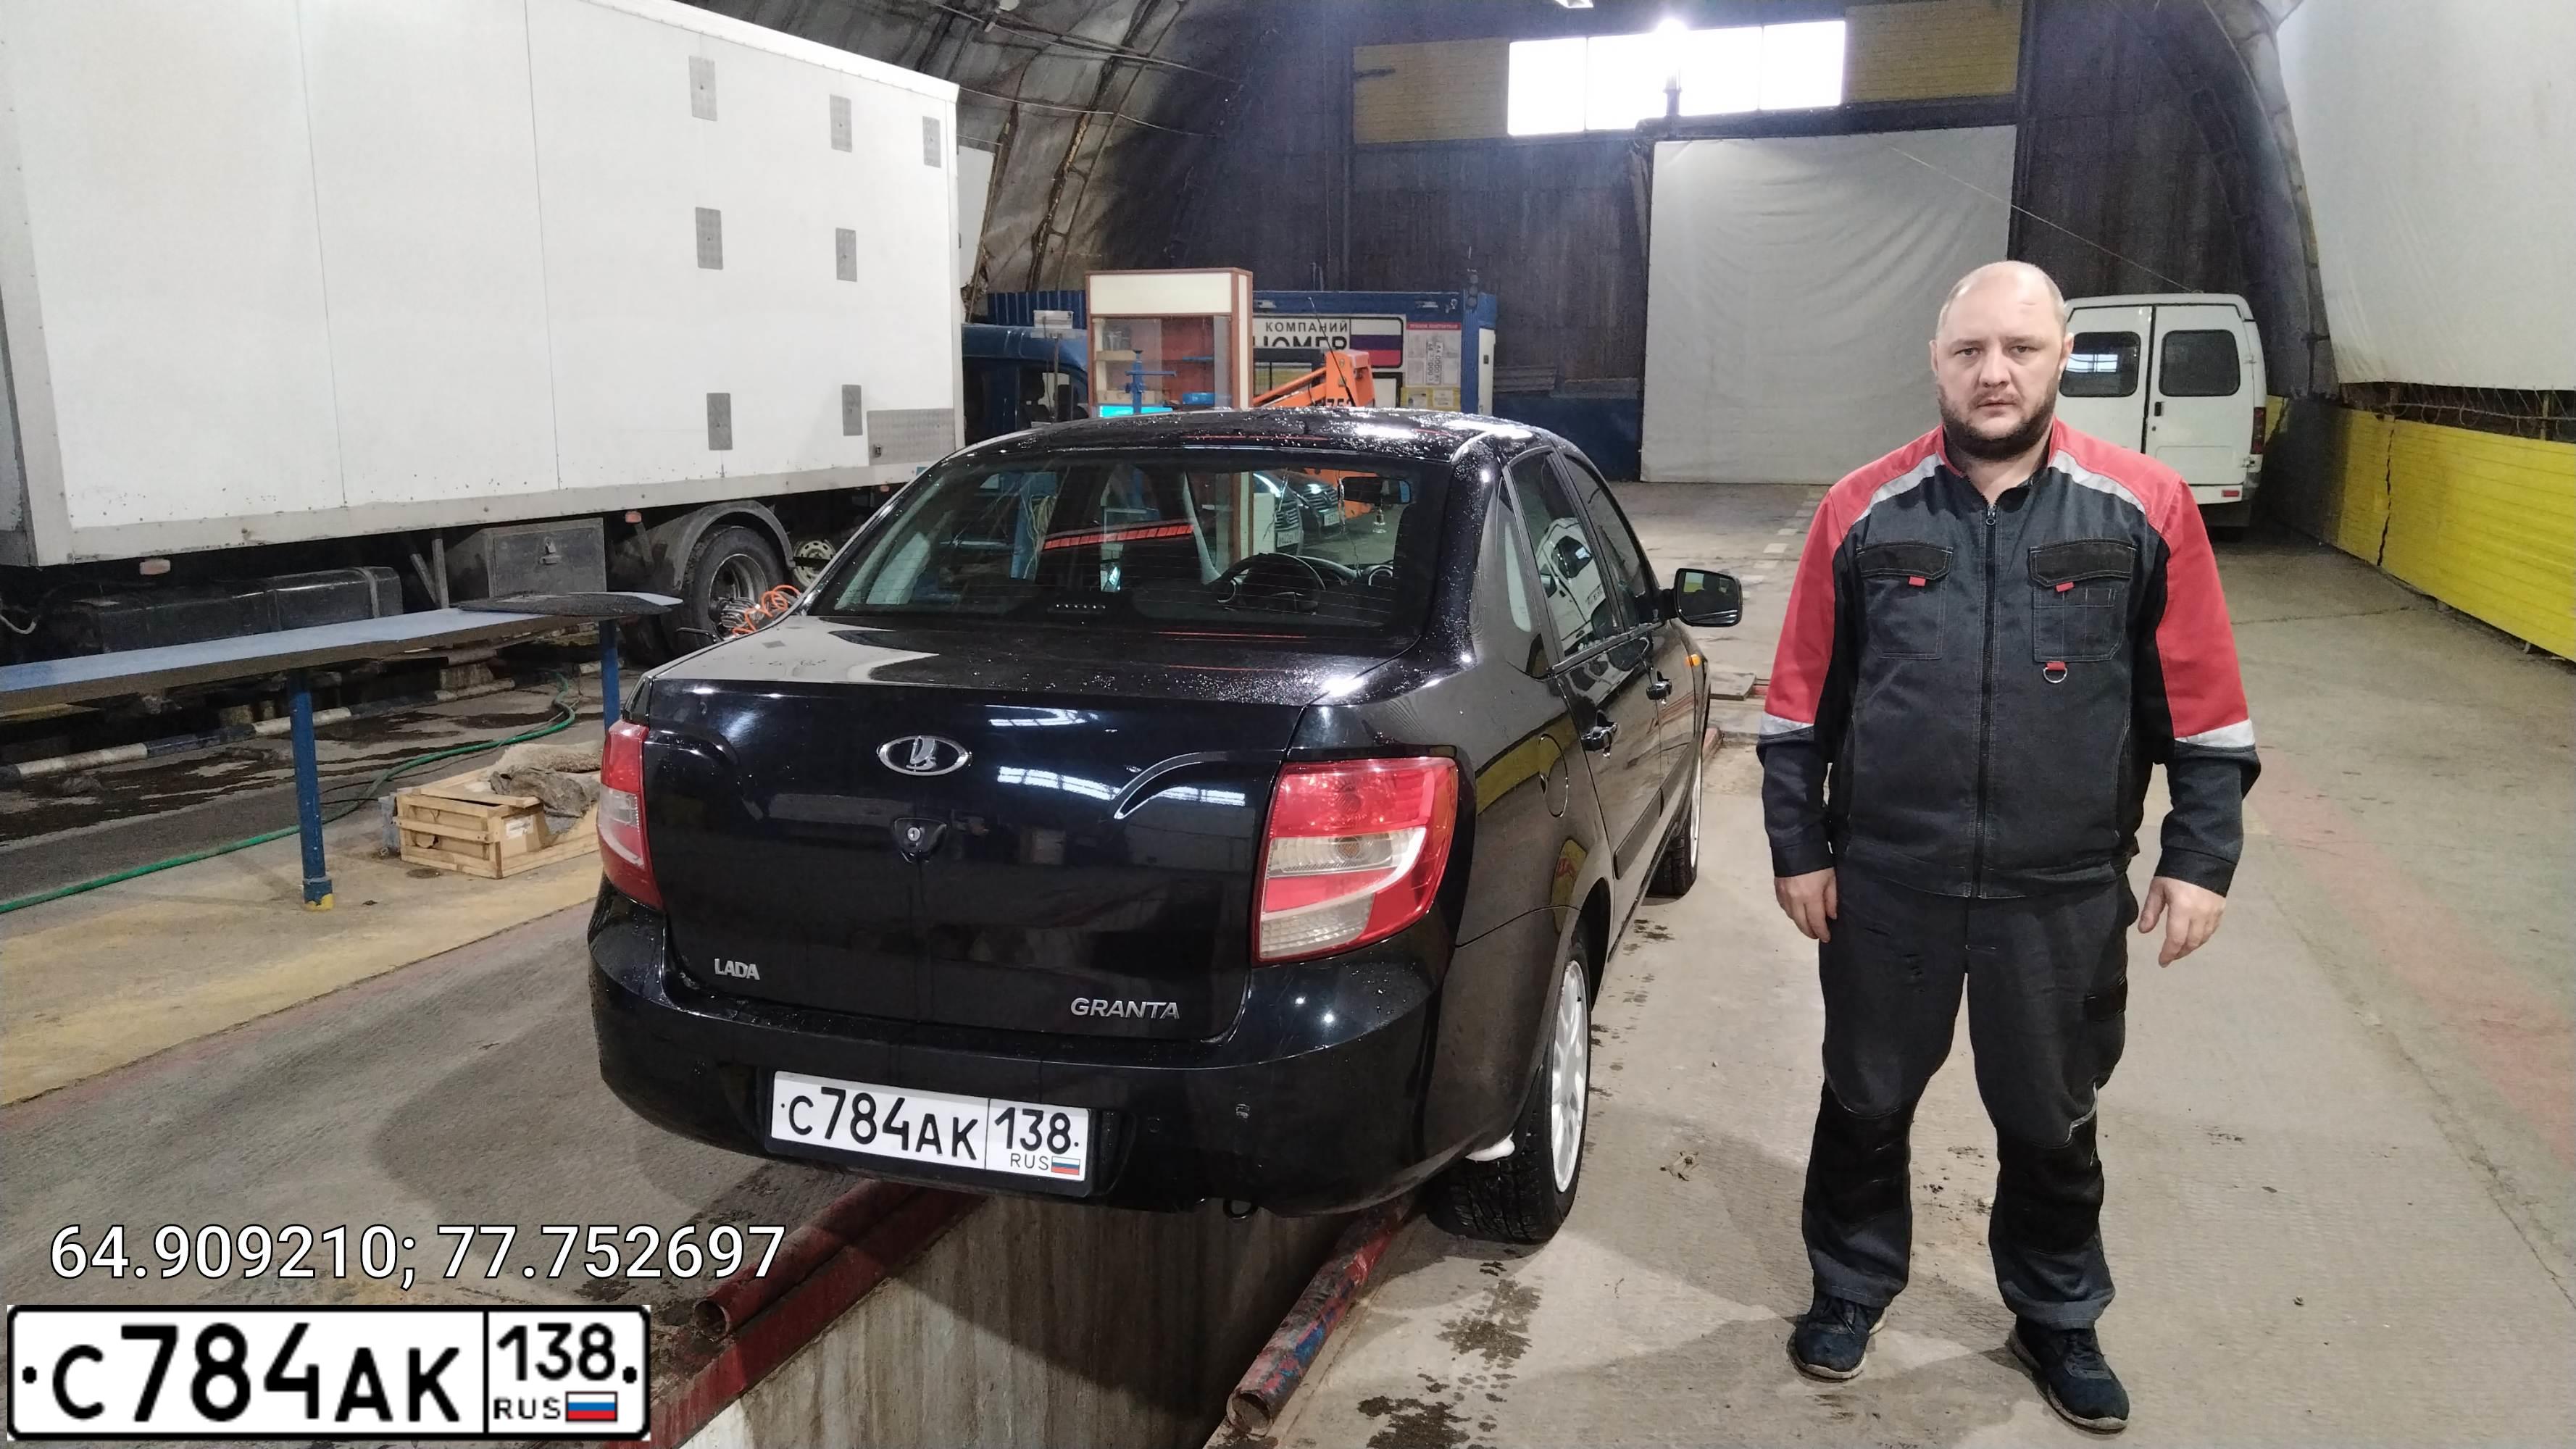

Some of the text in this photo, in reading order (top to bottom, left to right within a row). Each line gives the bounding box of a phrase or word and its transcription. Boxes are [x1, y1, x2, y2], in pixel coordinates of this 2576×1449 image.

[1266, 320, 1348, 333] КОМПАНИЙ
[714, 959, 760, 980] LADA
[1070, 997, 1180, 1019] GRANTA
[788, 1086, 1071, 1160] С784АК 138
[1009, 1153, 1049, 1171] RUS
